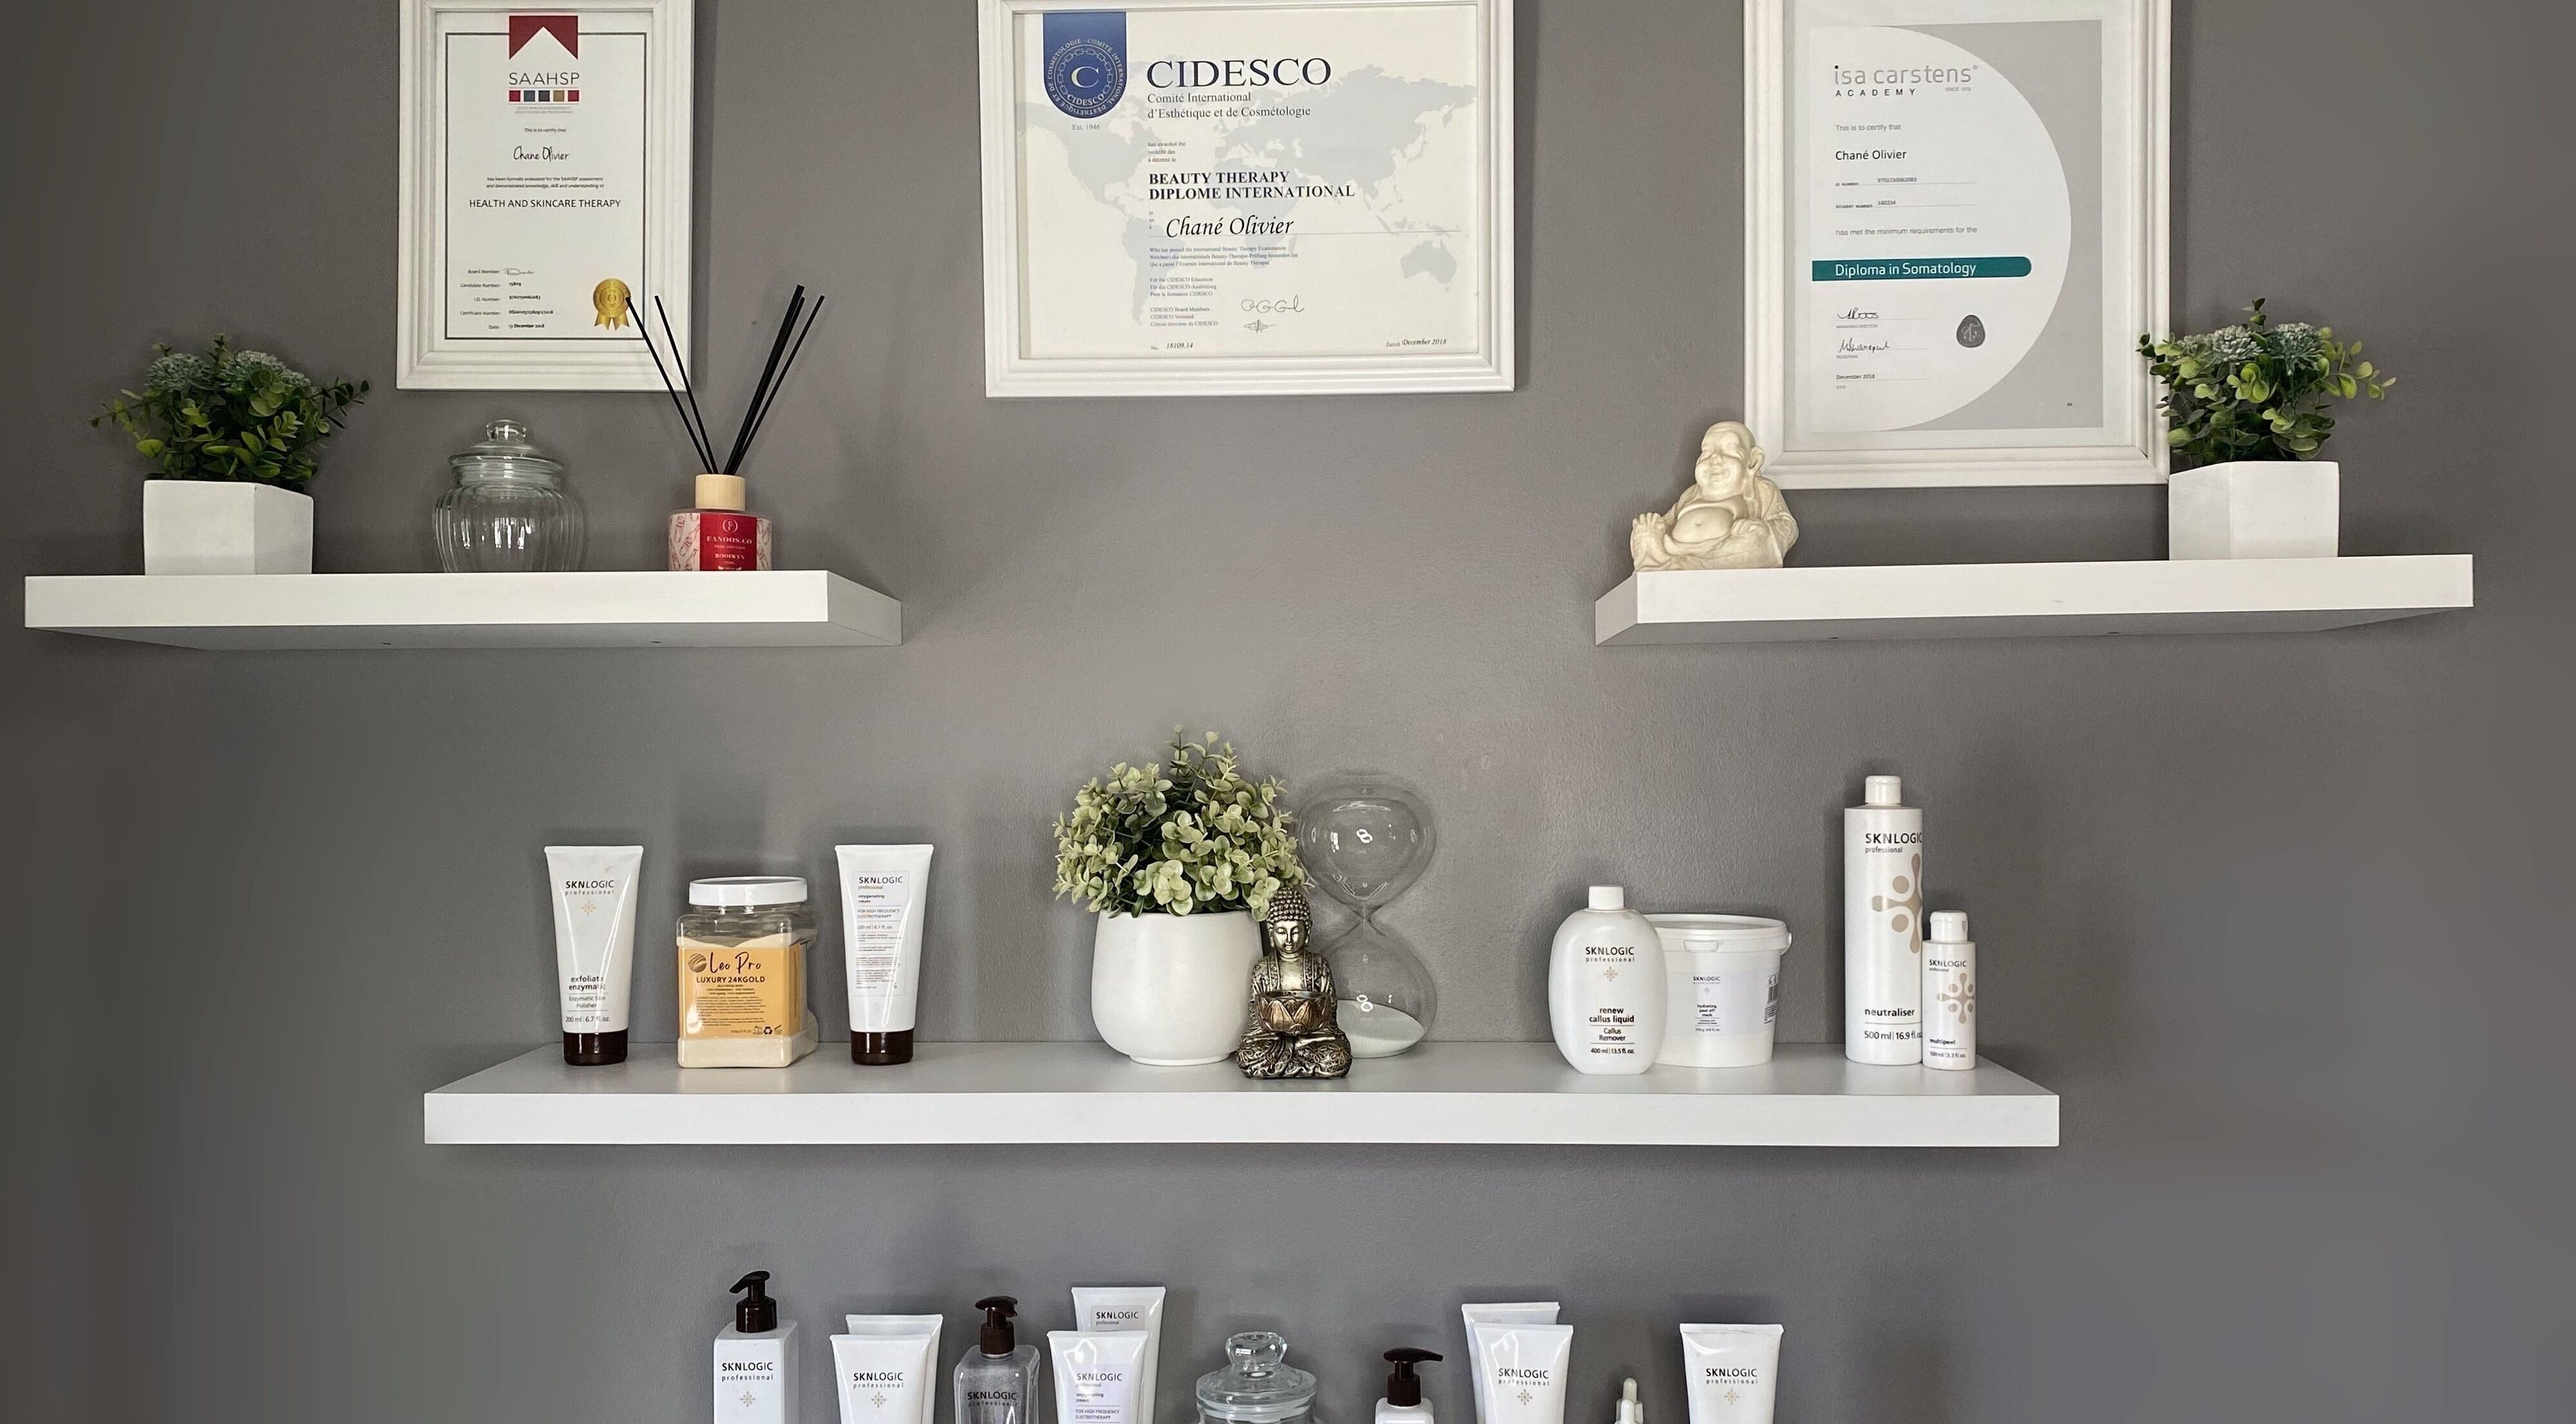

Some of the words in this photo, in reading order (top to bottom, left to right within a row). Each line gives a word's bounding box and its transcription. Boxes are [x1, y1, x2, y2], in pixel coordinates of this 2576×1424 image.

[508, 72, 580, 85] SAAHSP
[1146, 58, 1332, 89] CIDESCO
[1834, 64, 1866, 85] isa
[1873, 65, 1972, 85] carstens
[1147, 93, 1185, 103] Comité
[1187, 91, 1251, 103] International
[1835, 88, 1915, 97] ACADEMY
[1067, 94, 1105, 106] CIDESCO
[1214, 109, 1223, 117] et
[1226, 107, 1238, 117] de
[1240, 105, 1311, 119] Cosmétologie
[1866, 123, 1888, 132] certify
[542, 146, 570, 162] Olivier
[1835, 150, 1869, 160] Chané
[1872, 150, 1907, 160] Olivier
[1149, 172, 1212, 184] BEAUTY
[1216, 171, 1289, 184] THERAPY
[1149, 187, 1221, 200] DIPLOME
[1226, 185, 1355, 199] INTERNATIONAL
[469, 199, 506, 208] HEALTH
[507, 199, 529, 208] AND
[530, 199, 576, 208] SKINCARE
[578, 199, 621, 208] THERAPY
[1166, 215, 1224, 238] Chané
[1229, 214, 1295, 235] Olivier
[1835, 264, 1886, 278] Diploma
[1889, 263, 1900, 275] in
[1902, 262, 1976, 279] Somatology
[706, 536, 752, 545] FANOOS.CO
[1865, 845, 1903, 854] professional
[566, 879, 614, 889] SKNLOGIC
[859, 876, 903, 884] SKNLOGIC
[1585, 946, 1634, 956] SKNLOGIC
[709, 952, 731, 974] Leo
[735, 951, 761, 975] Pro
[1929, 959, 1967, 968] SKNLOGIC
[1864, 1007, 1915, 1017] neutraliser
[1589, 1015, 1611, 1023] callus
[1613, 1015, 1635, 1024] liquid
[1864, 1030, 1880, 1040] 500
[1880, 1032, 1892, 1040] ml
[1895, 1031, 1911, 1040] 16.9
[1096, 1311, 1139, 1319] SKNLOGIC
[722, 1362, 773, 1372] SKNLOGIC
[853, 1372, 904, 1382] SKNLOGIC
[1077, 1372, 1122, 1382] SKNLOGIC
[1498, 1368, 1549, 1379] SKNLOGIC
[1706, 1368, 1757, 1377] SKNLOGIC
[721, 1374, 773, 1382] professional
[1498, 1378, 1550, 1386] professional
[853, 1382, 904, 1390] professional
[967, 1391, 1017, 1401] SKNLOGIC
